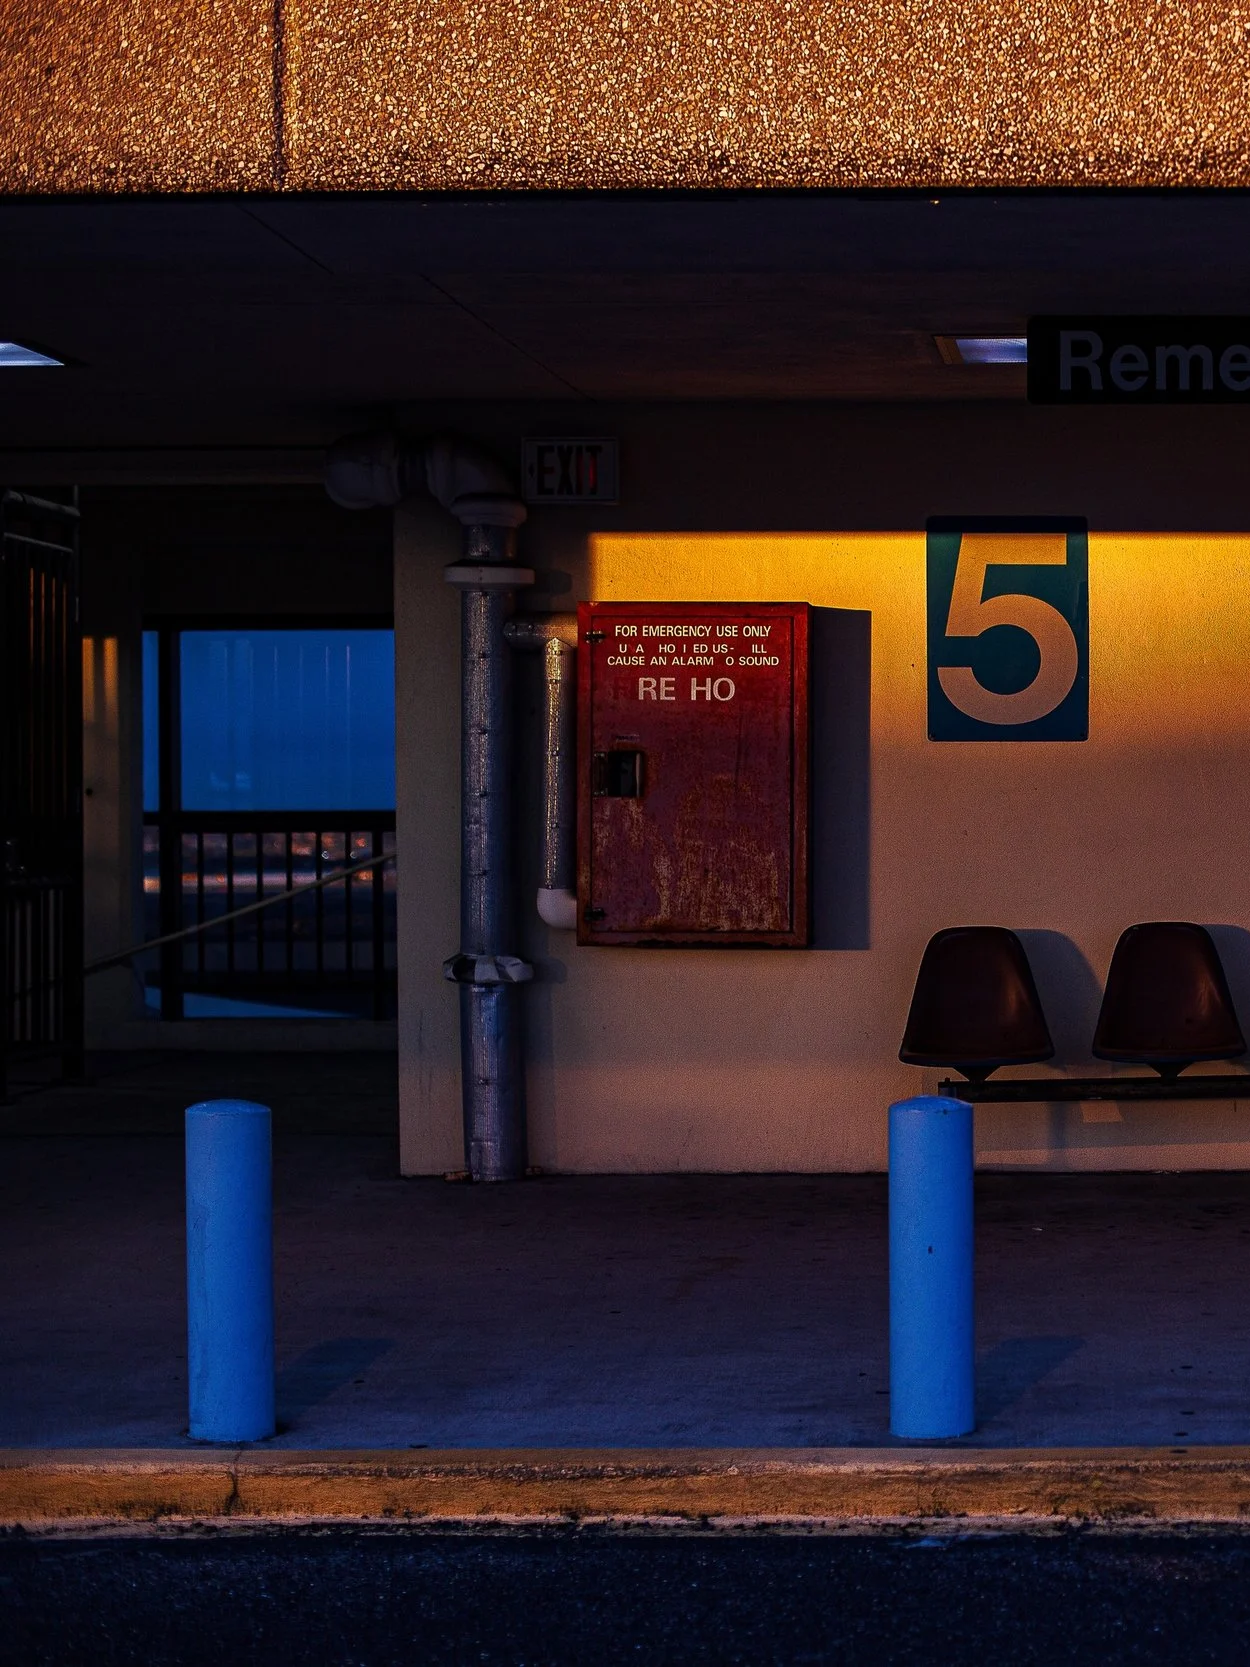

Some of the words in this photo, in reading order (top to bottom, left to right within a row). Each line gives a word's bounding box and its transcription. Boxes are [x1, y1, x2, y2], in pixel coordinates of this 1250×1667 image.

[537, 445, 602, 495] EXIT
[615, 625, 638, 638] FOR
[642, 625, 713, 638] EMERGENCY
[716, 625, 738, 638] USE
[743, 625, 772, 638] ONLY
[937, 532, 1079, 726] 5
[607, 656, 646, 667] CAUSE
[650, 656, 668, 667] AN
[672, 656, 715, 667] ALARM
[738, 656, 780, 667] SOUND
